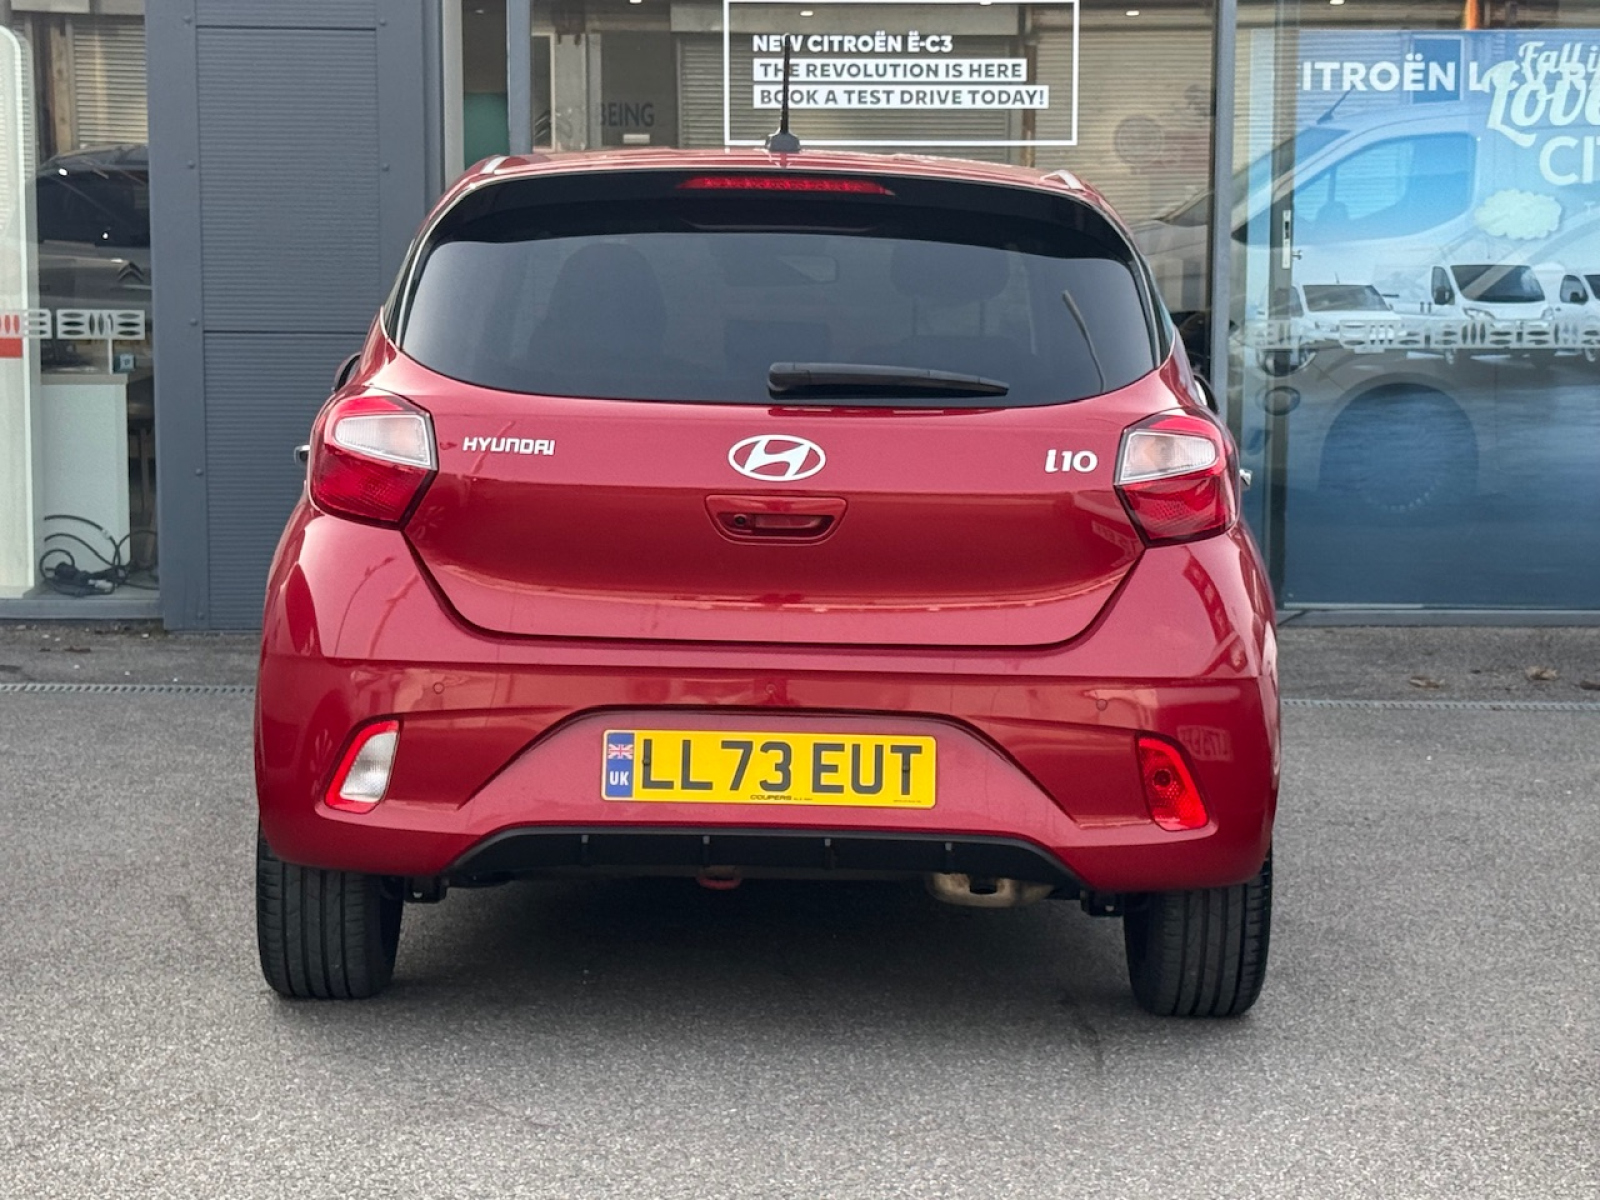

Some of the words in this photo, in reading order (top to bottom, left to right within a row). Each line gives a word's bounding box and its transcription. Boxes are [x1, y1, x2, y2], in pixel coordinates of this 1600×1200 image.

[752, 35, 803, 52] NEW
[806, 30, 902, 52] CITROËN
[907, 30, 953, 52] Ë-C3
[760, 63, 800, 78] THE
[805, 63, 939, 79] REVOLUTION
[945, 63, 964, 79] IS
[969, 63, 1022, 79] HERE
[1297, 53, 1456, 91] ITROËN
[760, 89, 819, 105] BOOK
[824, 89, 839, 105] A
[843, 89, 895, 105] TEST
[900, 89, 962, 105] DRIVE
[968, 89, 1045, 106] TODAY!
[462, 436, 556, 456] HYUNDAI
[642, 738, 793, 793] LL73
[811, 742, 924, 797] EUT
[609, 770, 630, 786] UK
